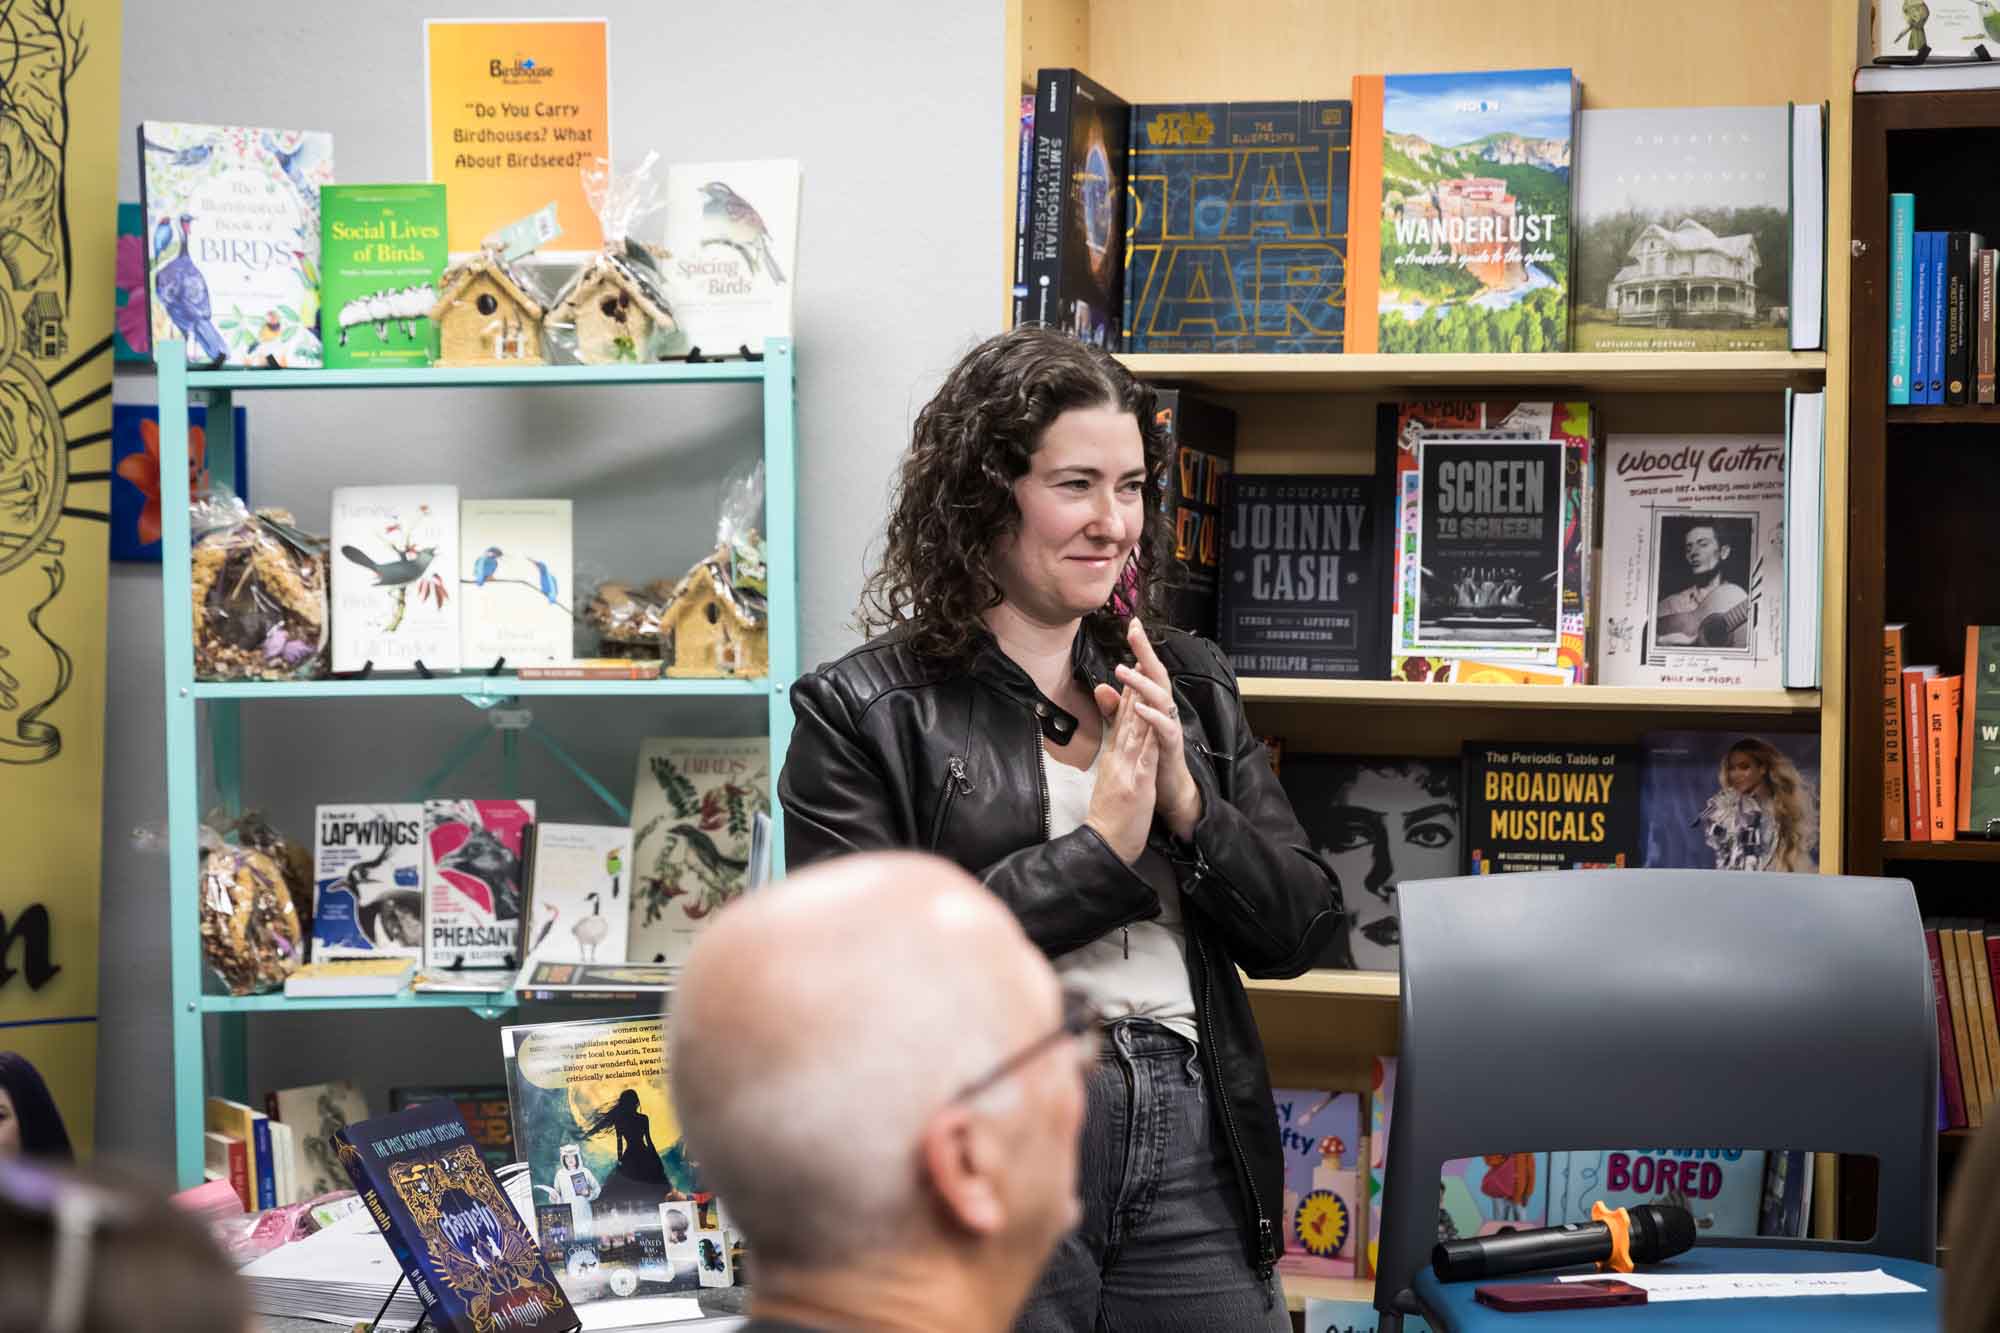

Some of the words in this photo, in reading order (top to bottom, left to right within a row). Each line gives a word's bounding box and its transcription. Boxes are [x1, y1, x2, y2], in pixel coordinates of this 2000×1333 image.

[501, 103, 529, 117] You
[535, 102, 580, 118] Carry
[453, 127, 548, 144] Birdhouses?
[553, 128, 592, 142] What
[455, 153, 501, 168] About
[1036, 136, 1050, 183] ATLAS
[1035, 188, 1048, 209] OF
[1044, 137, 1062, 259] SMITHSONIAN
[331, 221, 385, 240] Social
[389, 221, 440, 240] Lives
[1032, 213, 1047, 261] SPACE
[1394, 214, 1556, 245] WANDERLUST
[200, 239, 291, 270] BIRDS
[353, 244, 372, 262] of
[377, 244, 424, 262] Birds
[1982, 278, 1990, 321] WATCHING
[1616, 446, 1704, 482] Woody
[1438, 460, 1545, 514] SCREEN
[1230, 503, 1366, 551] JOHNNY
[1437, 517, 1458, 534] TO
[1252, 553, 1341, 602] CASH
[1883, 645, 1897, 686] WILD
[1885, 697, 1898, 763] WISDOM
[1931, 713, 1942, 732] LICE
[1486, 751, 1507, 763] The
[1511, 752, 1562, 765] Periodic
[1567, 753, 1599, 765] Table
[1602, 754, 1615, 765] of
[1485, 771, 1614, 804] BROADWAY
[321, 821, 420, 846] LAPWINGS
[1490, 809, 1606, 842] MUSICALS
[609, 1036, 650, 1046] speculative
[612, 1025, 638, 1034] women
[563, 1063, 584, 1074] Enjoy
[585, 1062, 599, 1070] our
[599, 1058, 638, 1069] wonderful,
[588, 1050, 605, 1058] local
[615, 1047, 640, 1057] Austin,
[605, 1070, 640, 1079] acclaimed
[641, 1068, 660, 1076] titles
[371, 1140, 390, 1159] THE
[386, 1136, 404, 1156] PAST
[401, 1129, 437, 1153] REMAINS
[1606, 1152, 1723, 1200] BORED
[363, 1188, 393, 1233] Hameln
